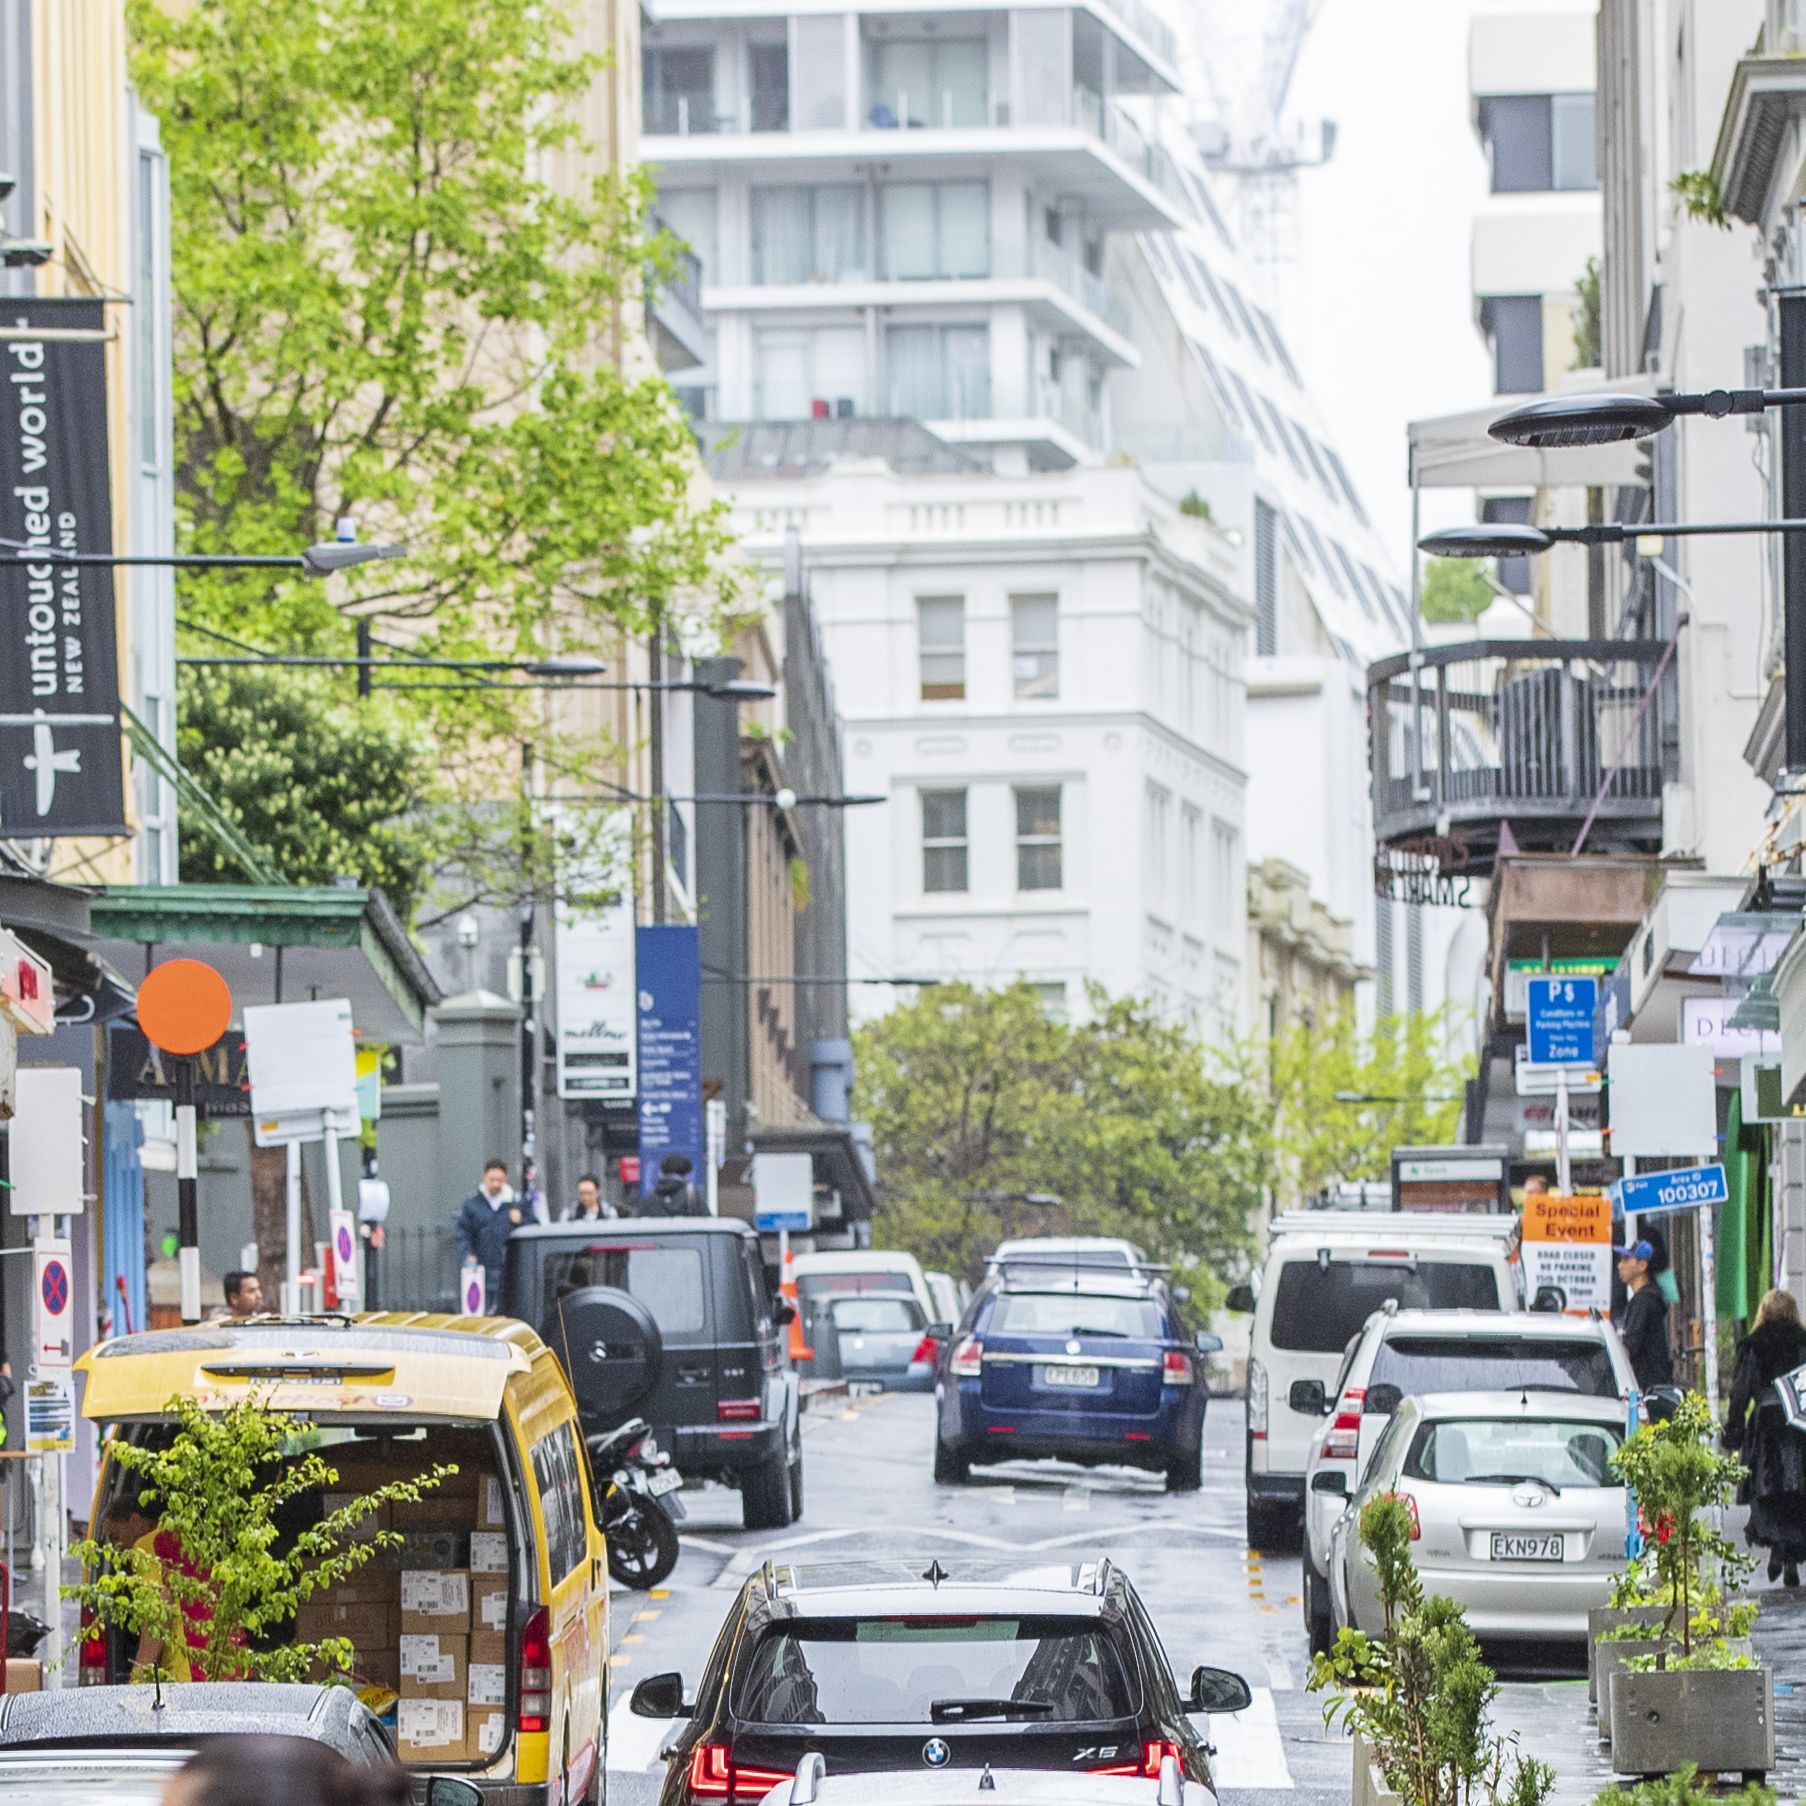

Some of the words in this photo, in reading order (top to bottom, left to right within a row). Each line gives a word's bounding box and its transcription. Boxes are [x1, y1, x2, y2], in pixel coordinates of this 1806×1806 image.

[8, 342, 47, 474] world
[64, 634, 84, 694] NEW
[1658, 1180, 1719, 1205] 100307
[1536, 1202, 1600, 1218] Special
[1546, 1222, 1596, 1237] Event
[1494, 1537, 1561, 1557] EKN978
